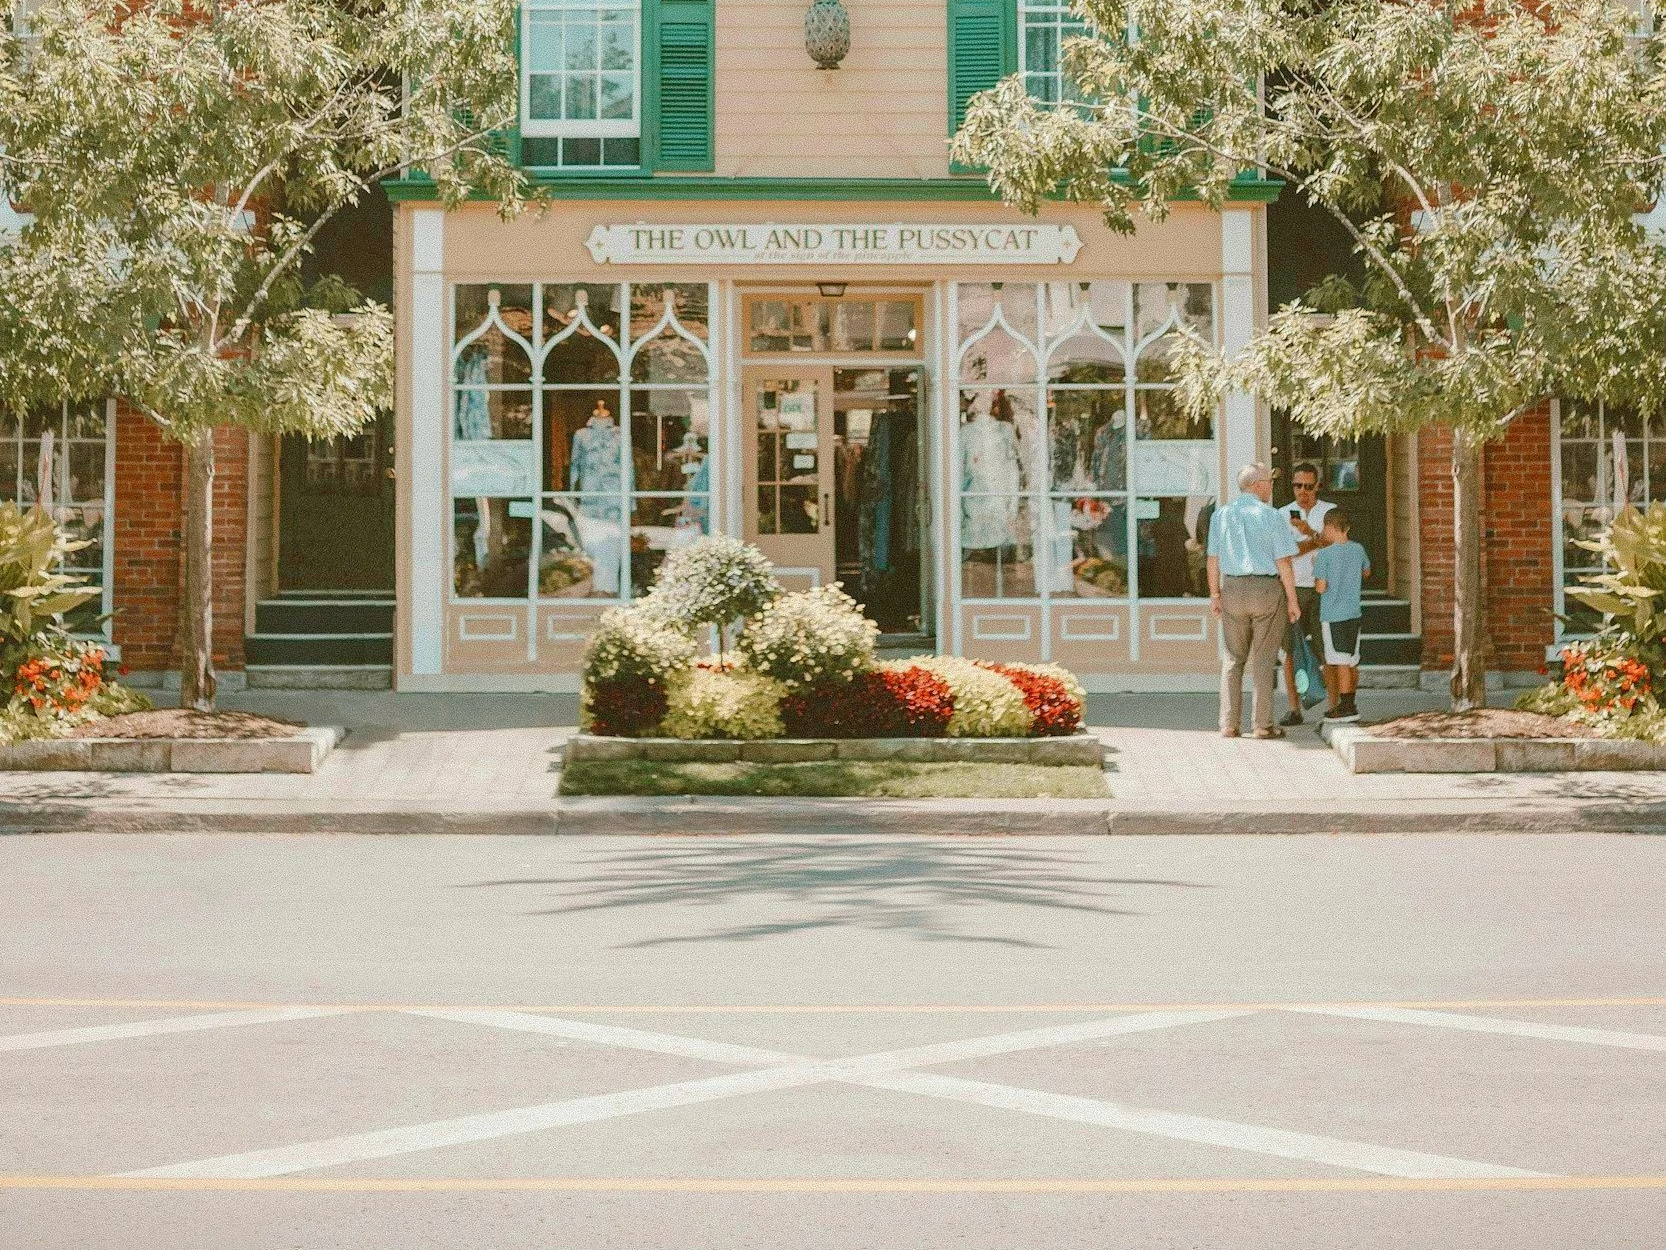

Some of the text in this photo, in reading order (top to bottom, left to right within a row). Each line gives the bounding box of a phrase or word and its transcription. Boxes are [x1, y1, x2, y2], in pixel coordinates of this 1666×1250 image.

[628, 229, 1039, 250] THE OWL AND THE PUSSYCAT
[768, 251, 786, 259] the
[832, 251, 851, 259] the
